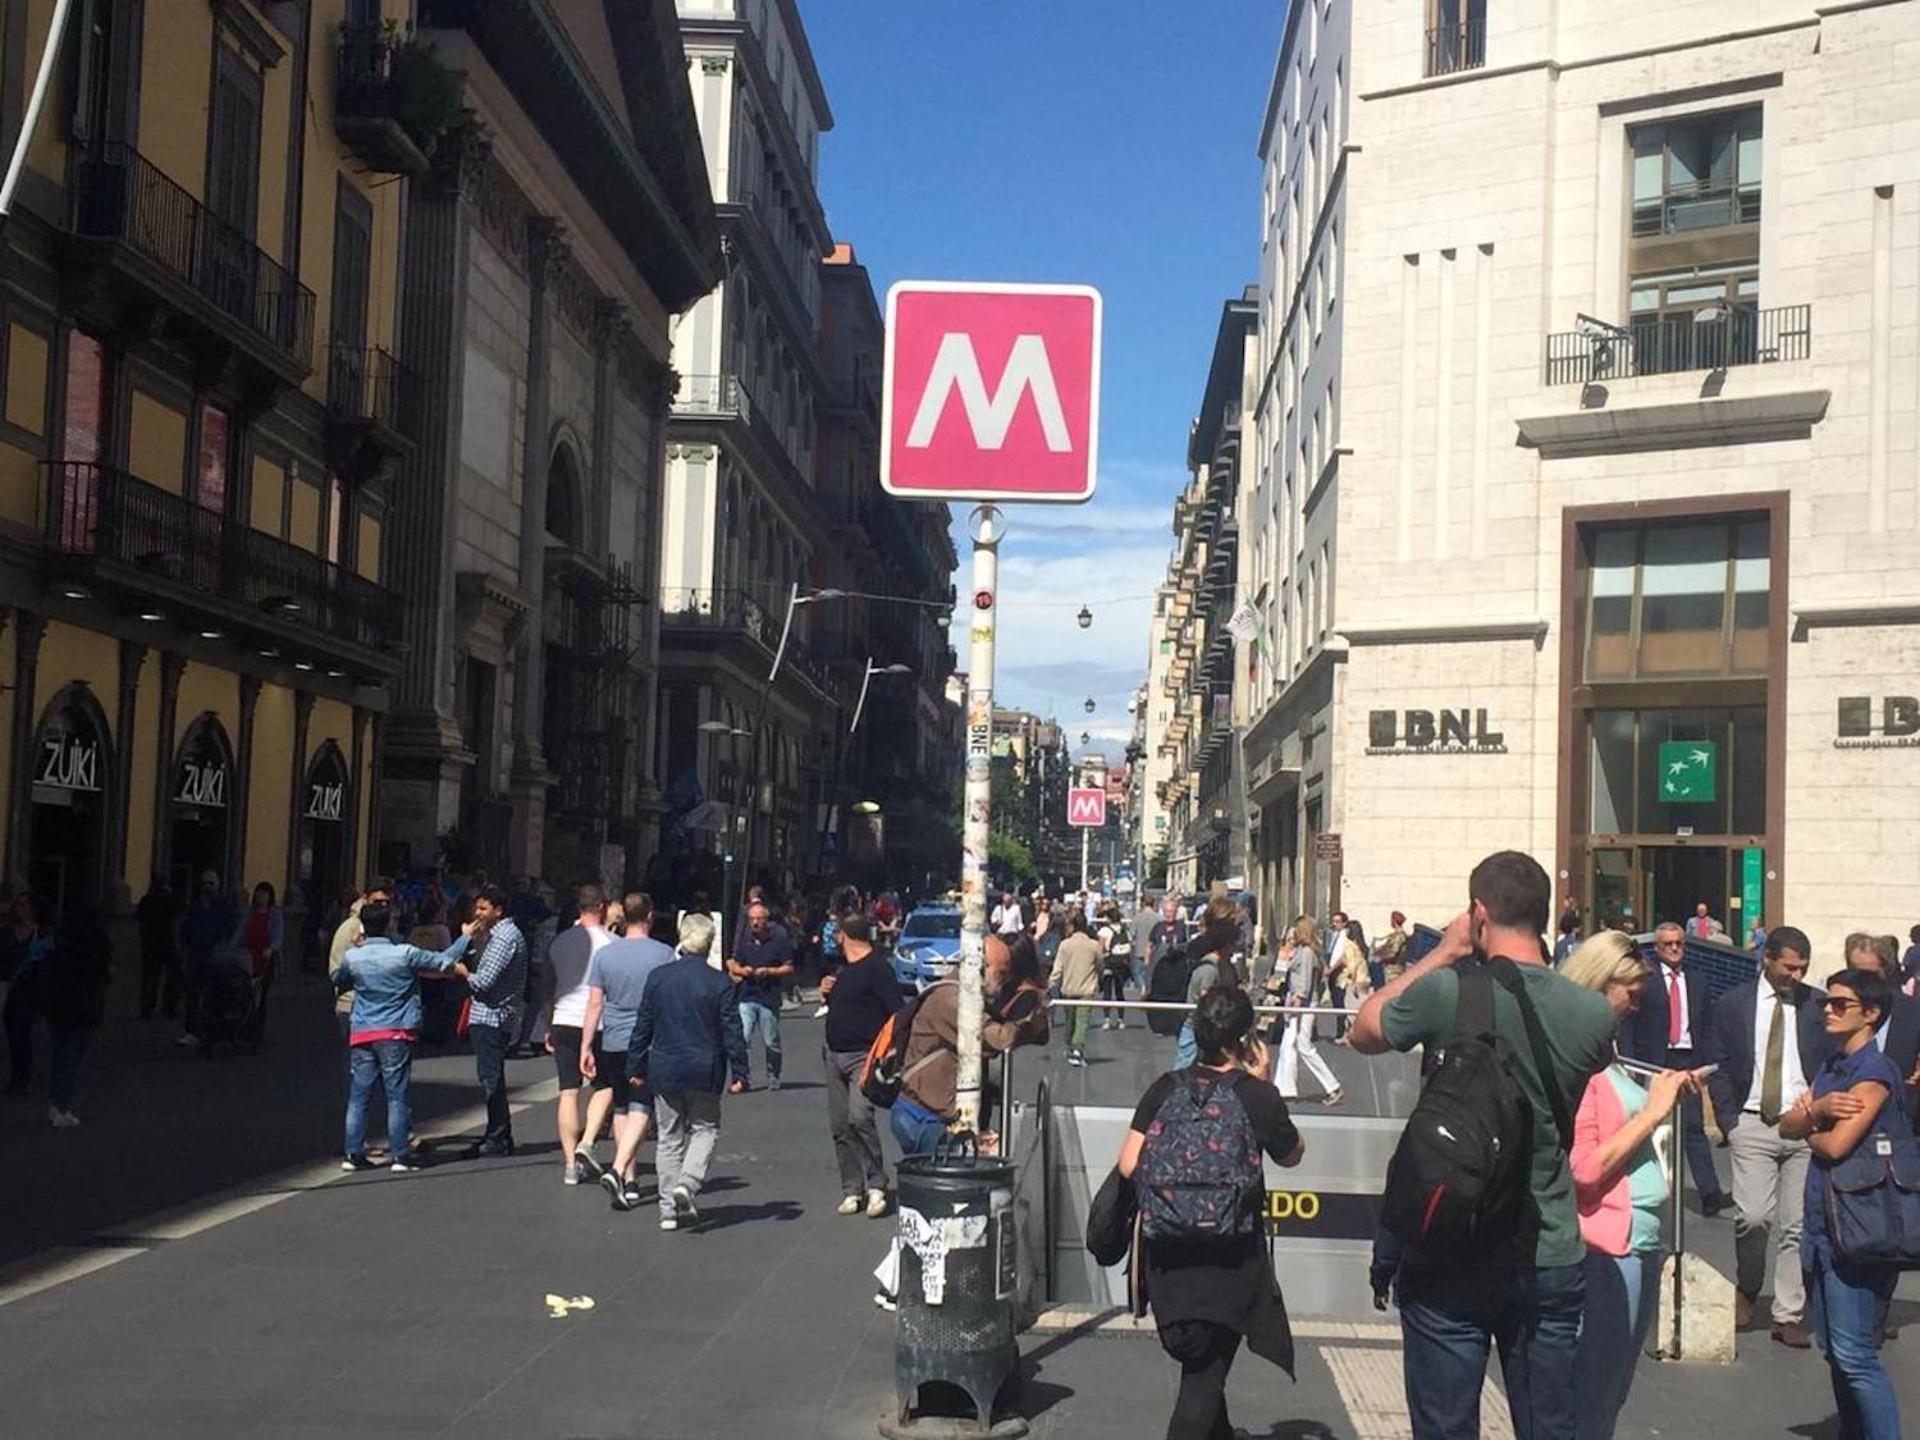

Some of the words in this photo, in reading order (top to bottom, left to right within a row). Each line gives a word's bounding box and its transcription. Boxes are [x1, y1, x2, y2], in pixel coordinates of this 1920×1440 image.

[905, 332, 1073, 452] M
[1405, 708, 1504, 745] BNL
[1073, 796, 1101, 817] M
